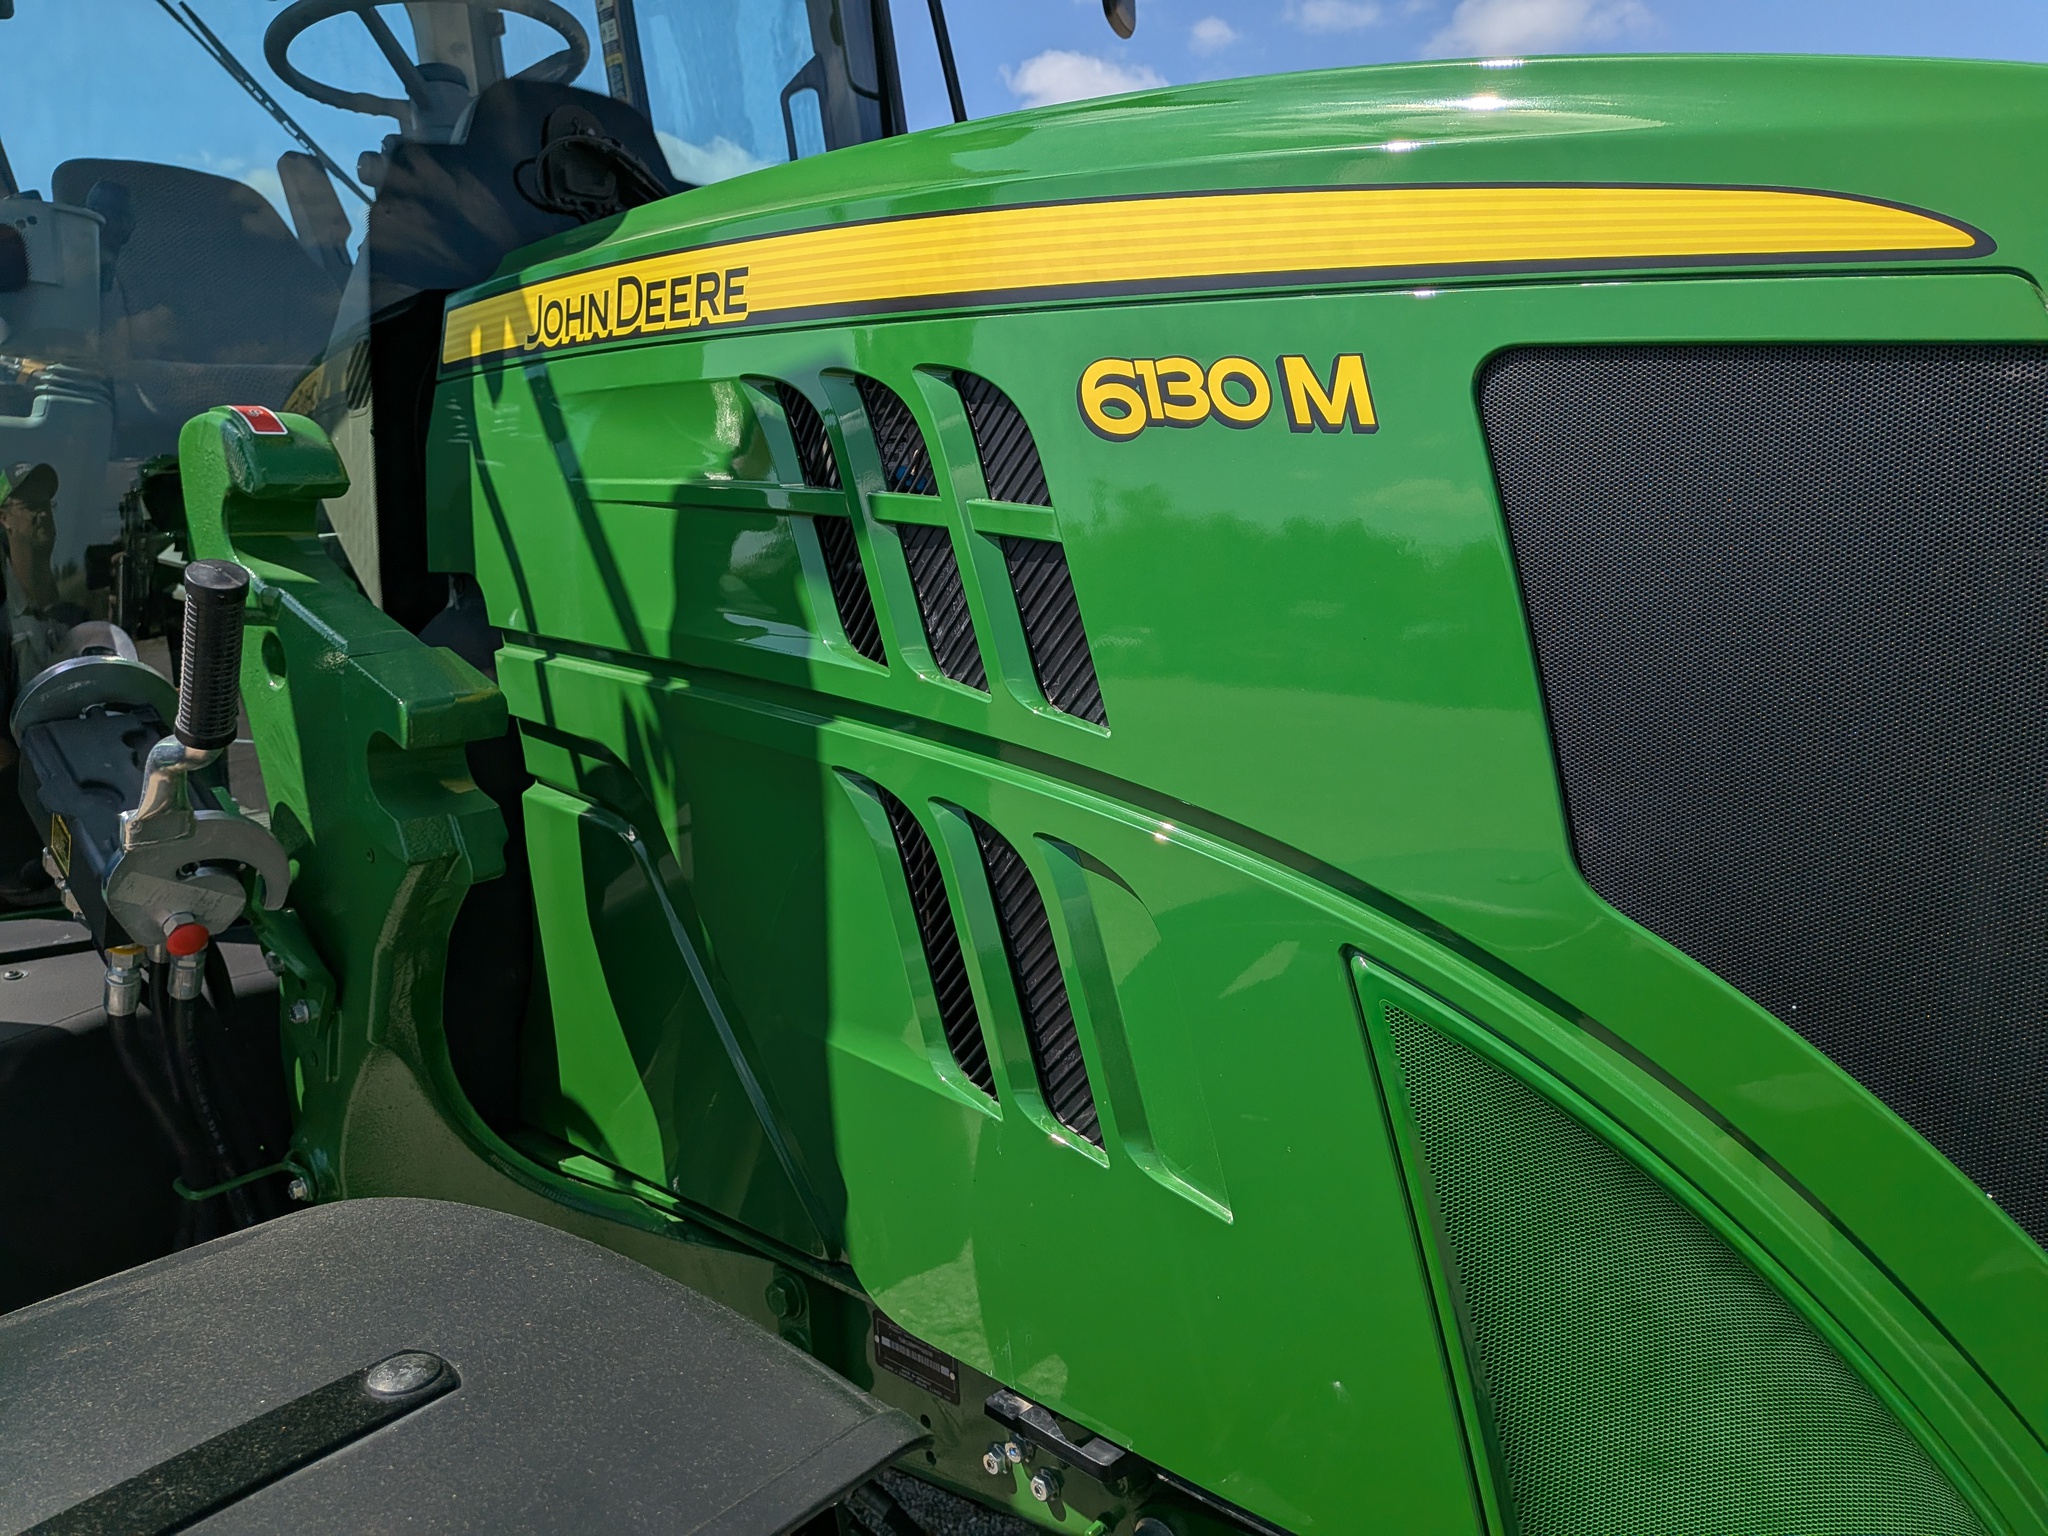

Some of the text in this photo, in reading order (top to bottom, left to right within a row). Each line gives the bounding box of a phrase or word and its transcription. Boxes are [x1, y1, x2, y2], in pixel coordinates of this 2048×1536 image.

[525, 265, 751, 347] JOHN DEERE
[1077, 352, 1380, 442] 6130 M
